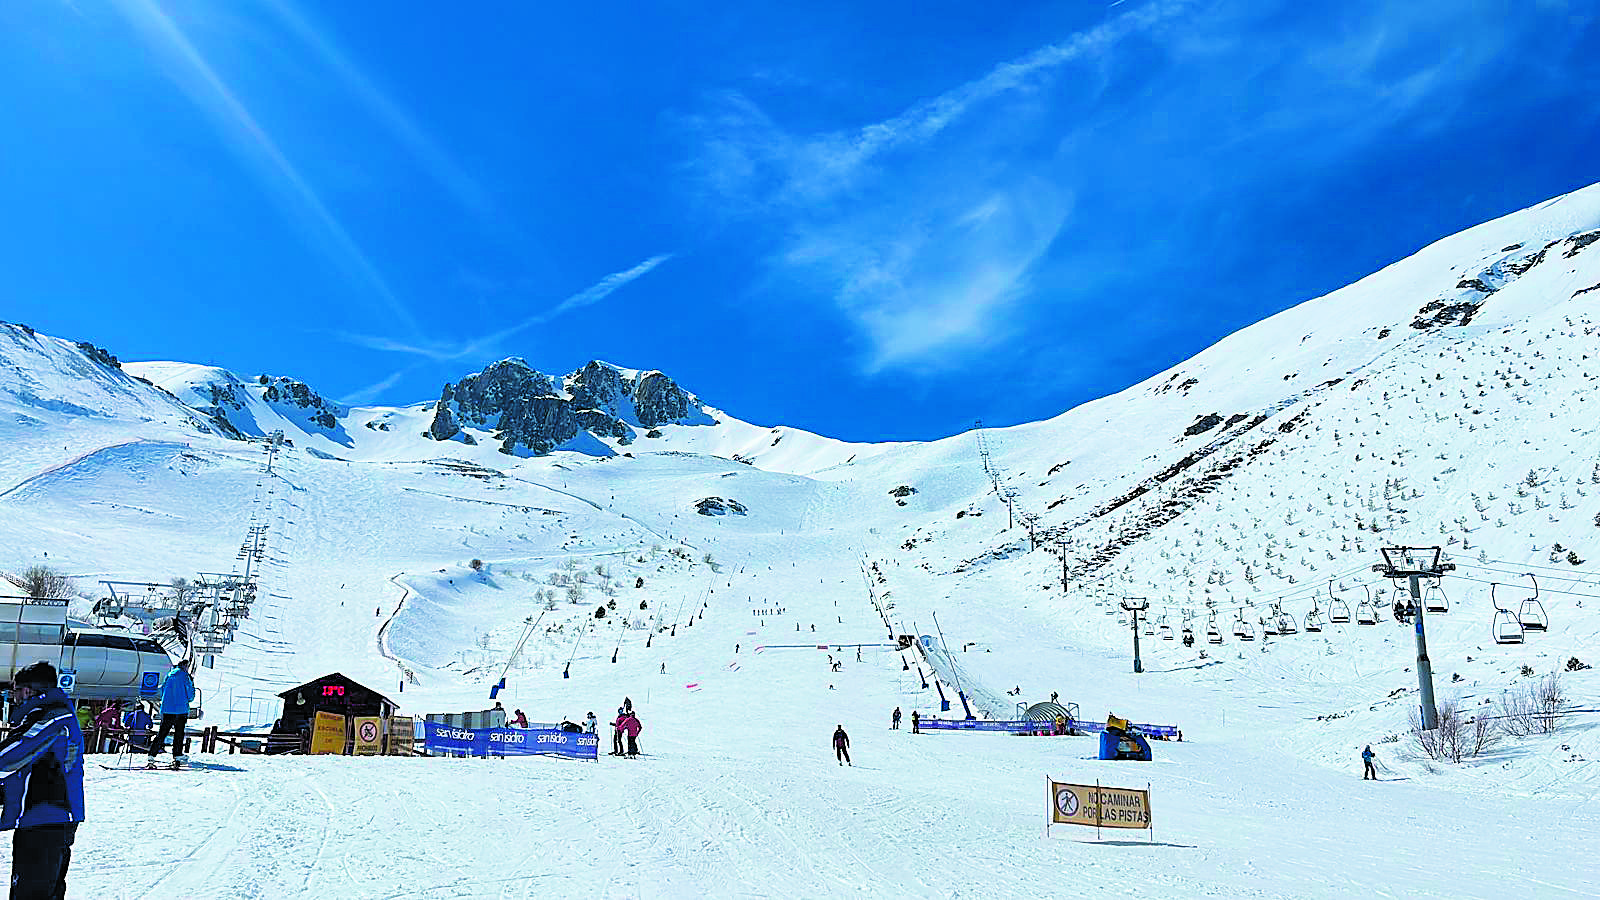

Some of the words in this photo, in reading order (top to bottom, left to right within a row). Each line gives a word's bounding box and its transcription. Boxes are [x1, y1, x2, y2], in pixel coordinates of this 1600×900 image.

[1088, 792, 1098, 804] NO
[1100, 792, 1141, 808] CAMINAR
[1083, 806, 1098, 818] POR
[1100, 808, 1117, 821] LAS
[1119, 810, 1149, 824] PISTAS
